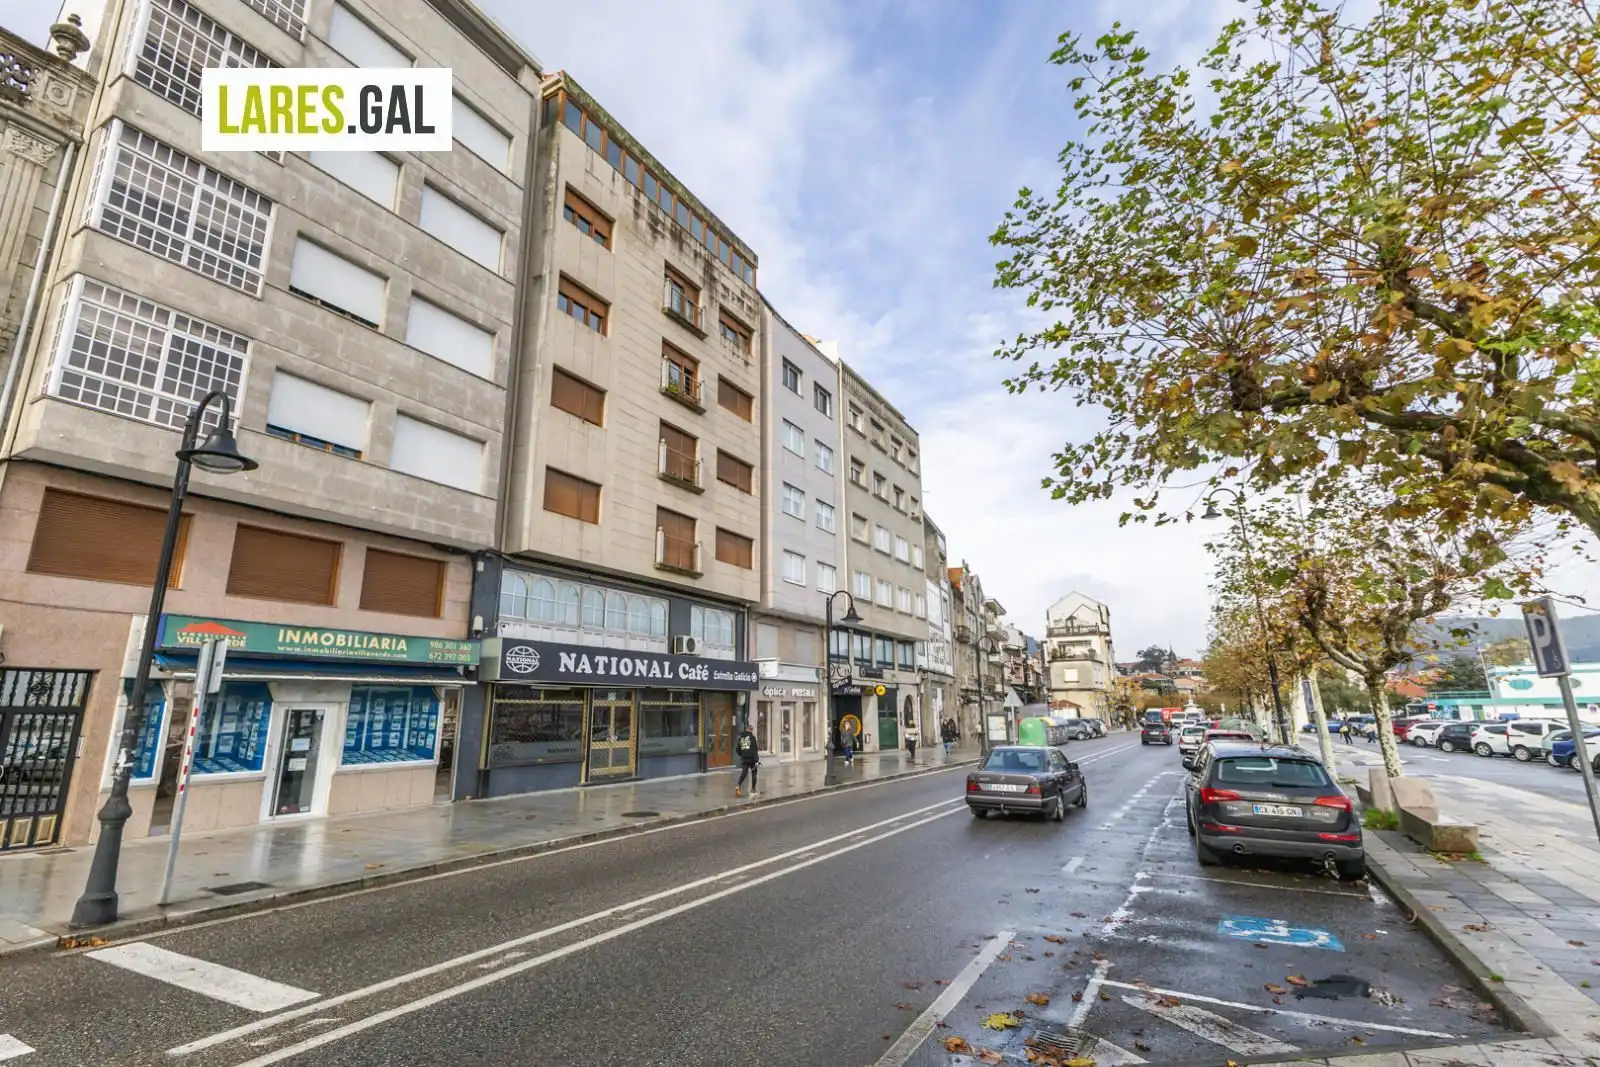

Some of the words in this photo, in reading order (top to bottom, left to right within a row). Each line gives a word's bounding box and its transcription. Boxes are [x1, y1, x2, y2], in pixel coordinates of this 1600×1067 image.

[177, 636, 247, 647] VILLRDE
[277, 628, 408, 651] INMOBILIARIA
[1526, 613, 1552, 672] P
[506, 655, 540, 664] NATIONAL
[558, 651, 674, 679] NATIONAL
[678, 662, 709, 681] Café
